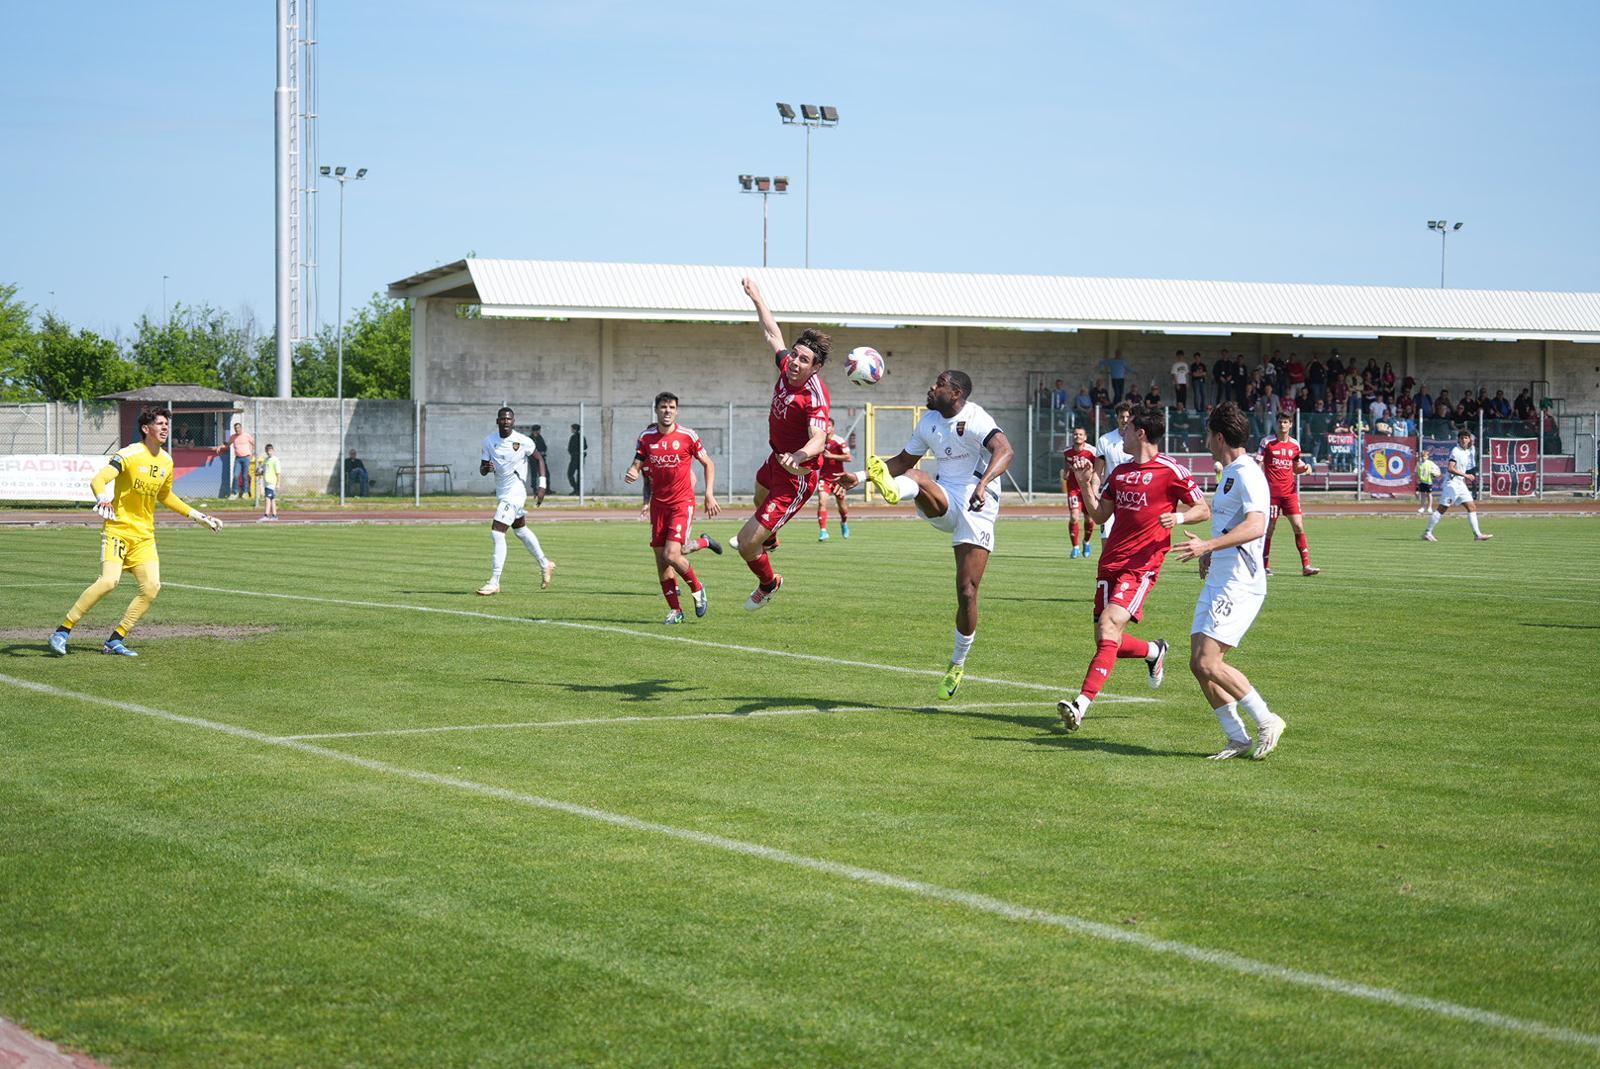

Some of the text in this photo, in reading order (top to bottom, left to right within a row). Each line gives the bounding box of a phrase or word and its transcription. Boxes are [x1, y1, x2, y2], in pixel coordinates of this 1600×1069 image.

[661, 441, 668, 450] 4
[1495, 443, 1530, 459] 1 9
[149, 464, 159, 478] 12
[1499, 464, 1527, 473] ADRIA
[1125, 471, 1141, 484] 27
[1522, 476, 1532, 491] 6
[504, 502, 511, 512] 6
[1068, 496, 1079, 508] 19
[980, 531, 991, 543] 29
[1215, 600, 1233, 617] 25
